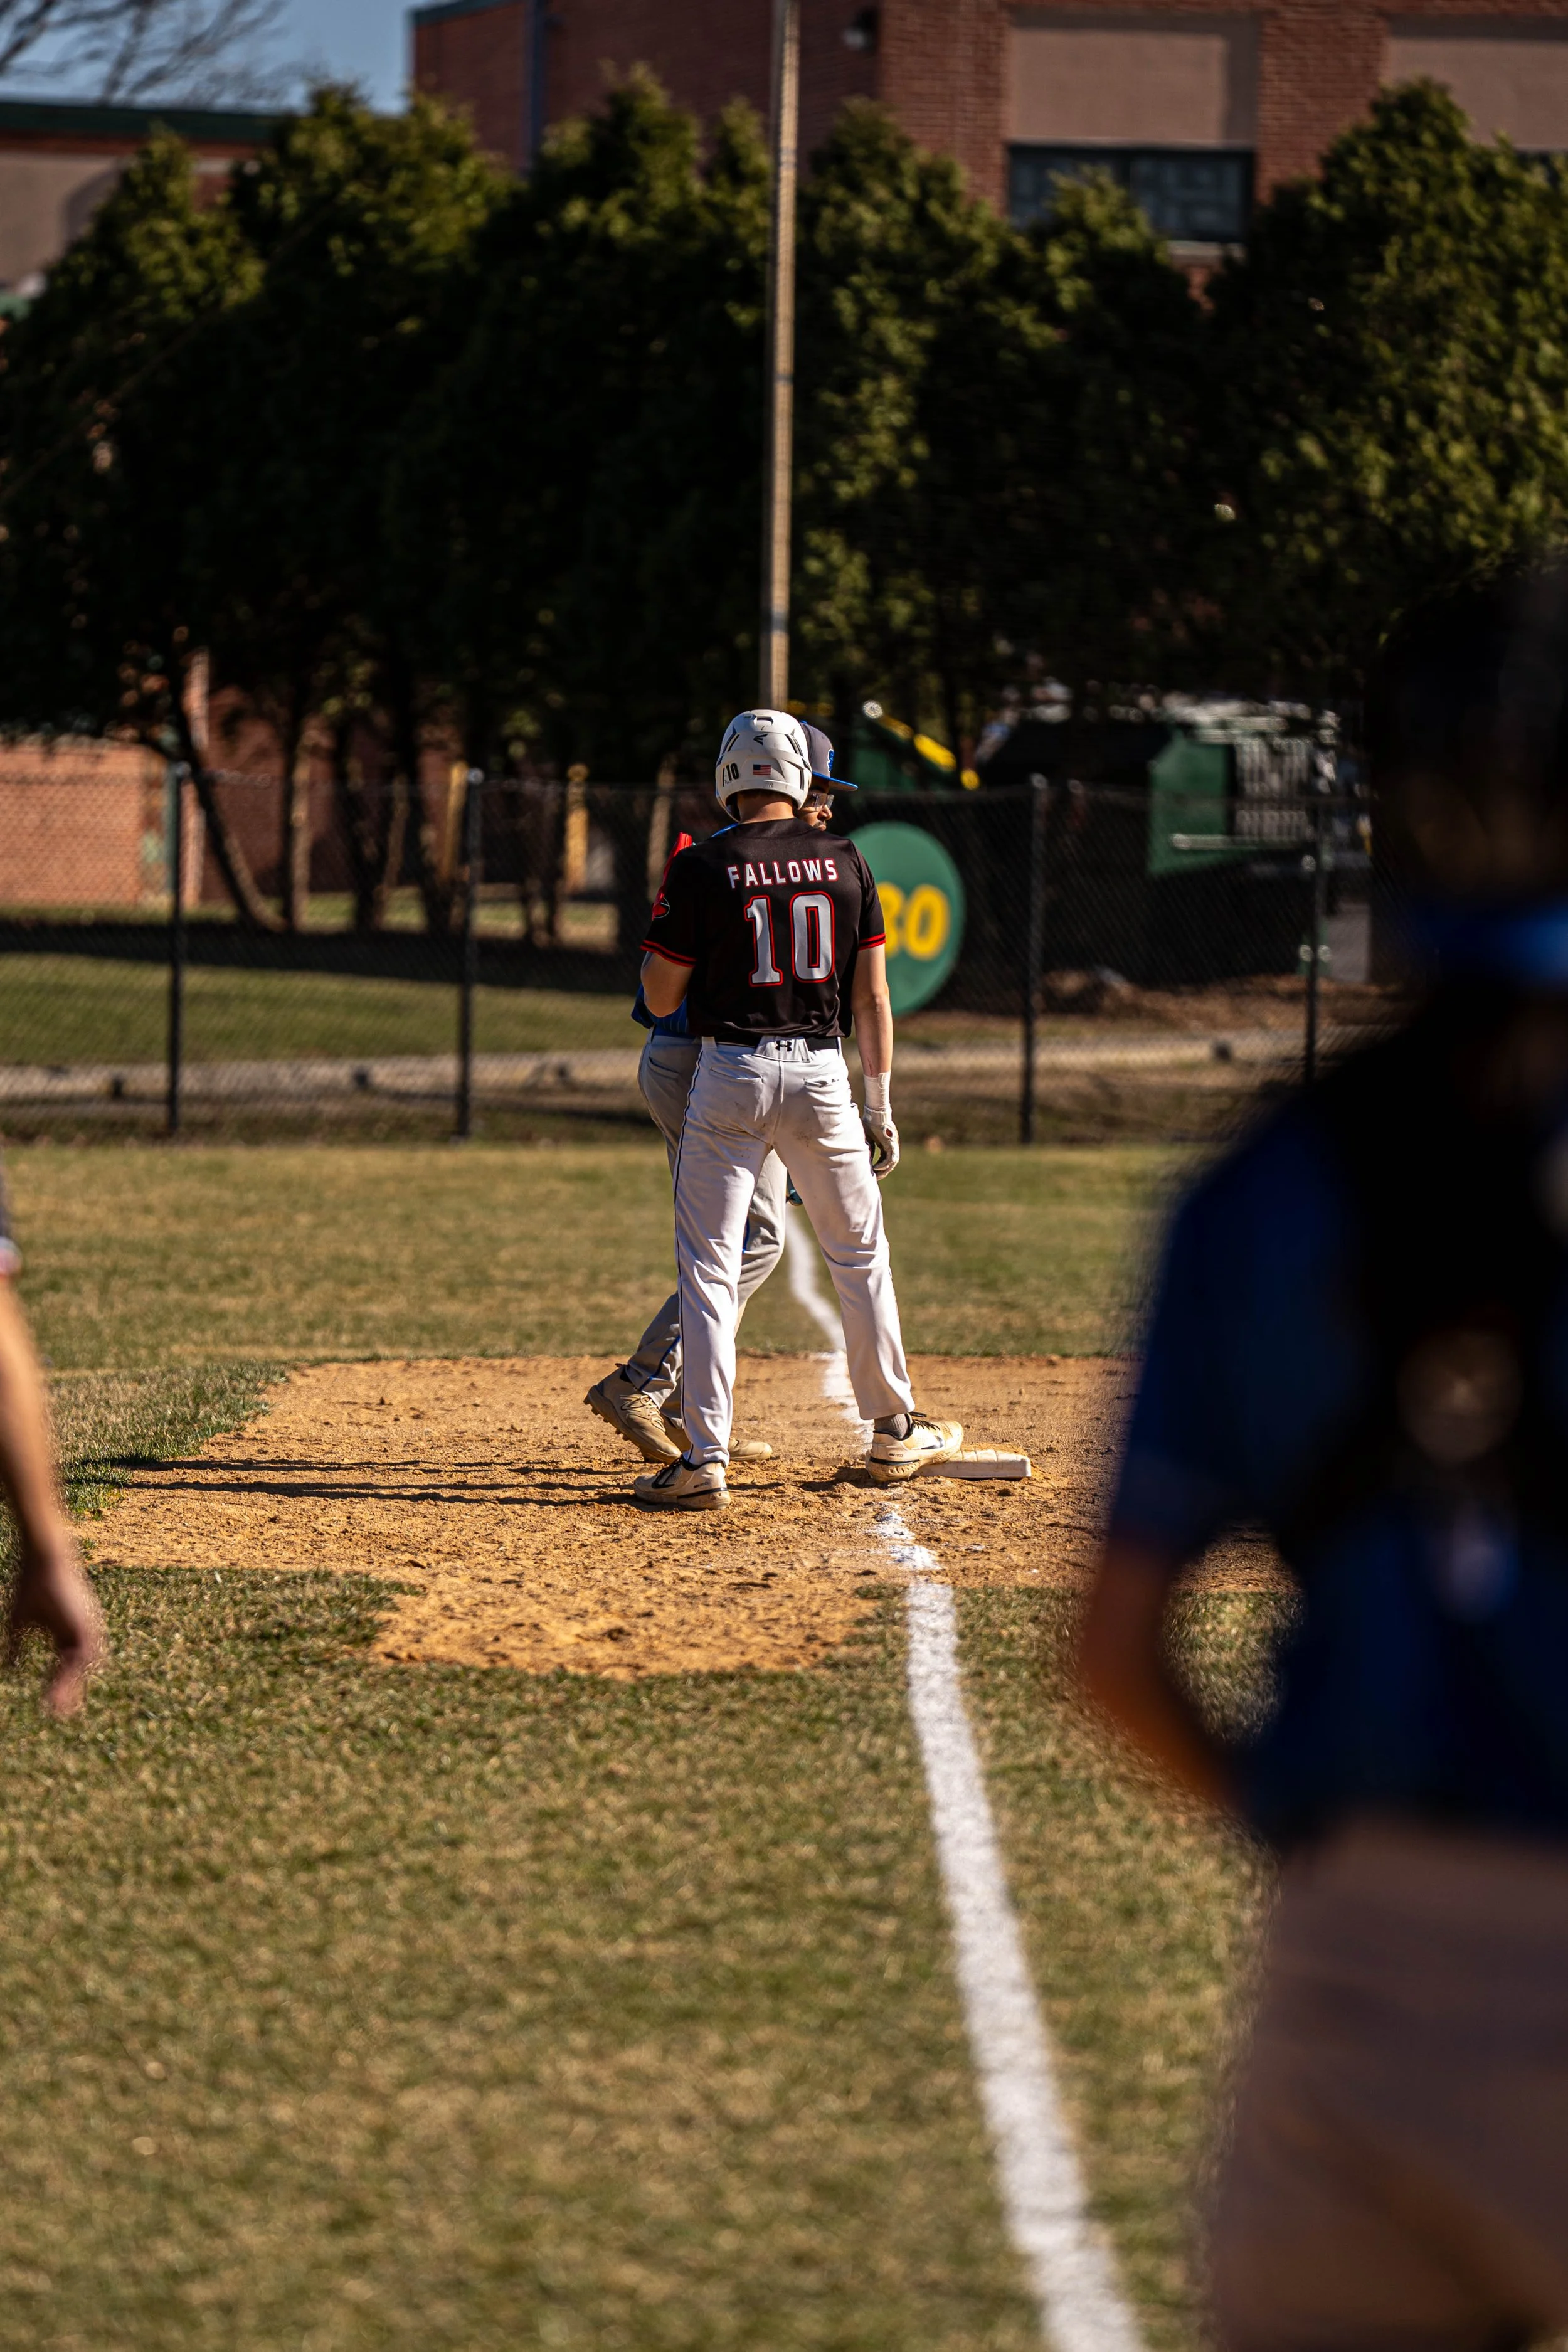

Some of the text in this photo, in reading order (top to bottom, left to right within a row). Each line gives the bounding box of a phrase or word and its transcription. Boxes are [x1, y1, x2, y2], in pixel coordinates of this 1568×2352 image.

[726, 763, 739, 781] 10
[726, 857, 839, 889] FALLOWS
[744, 891, 835, 987] 10
